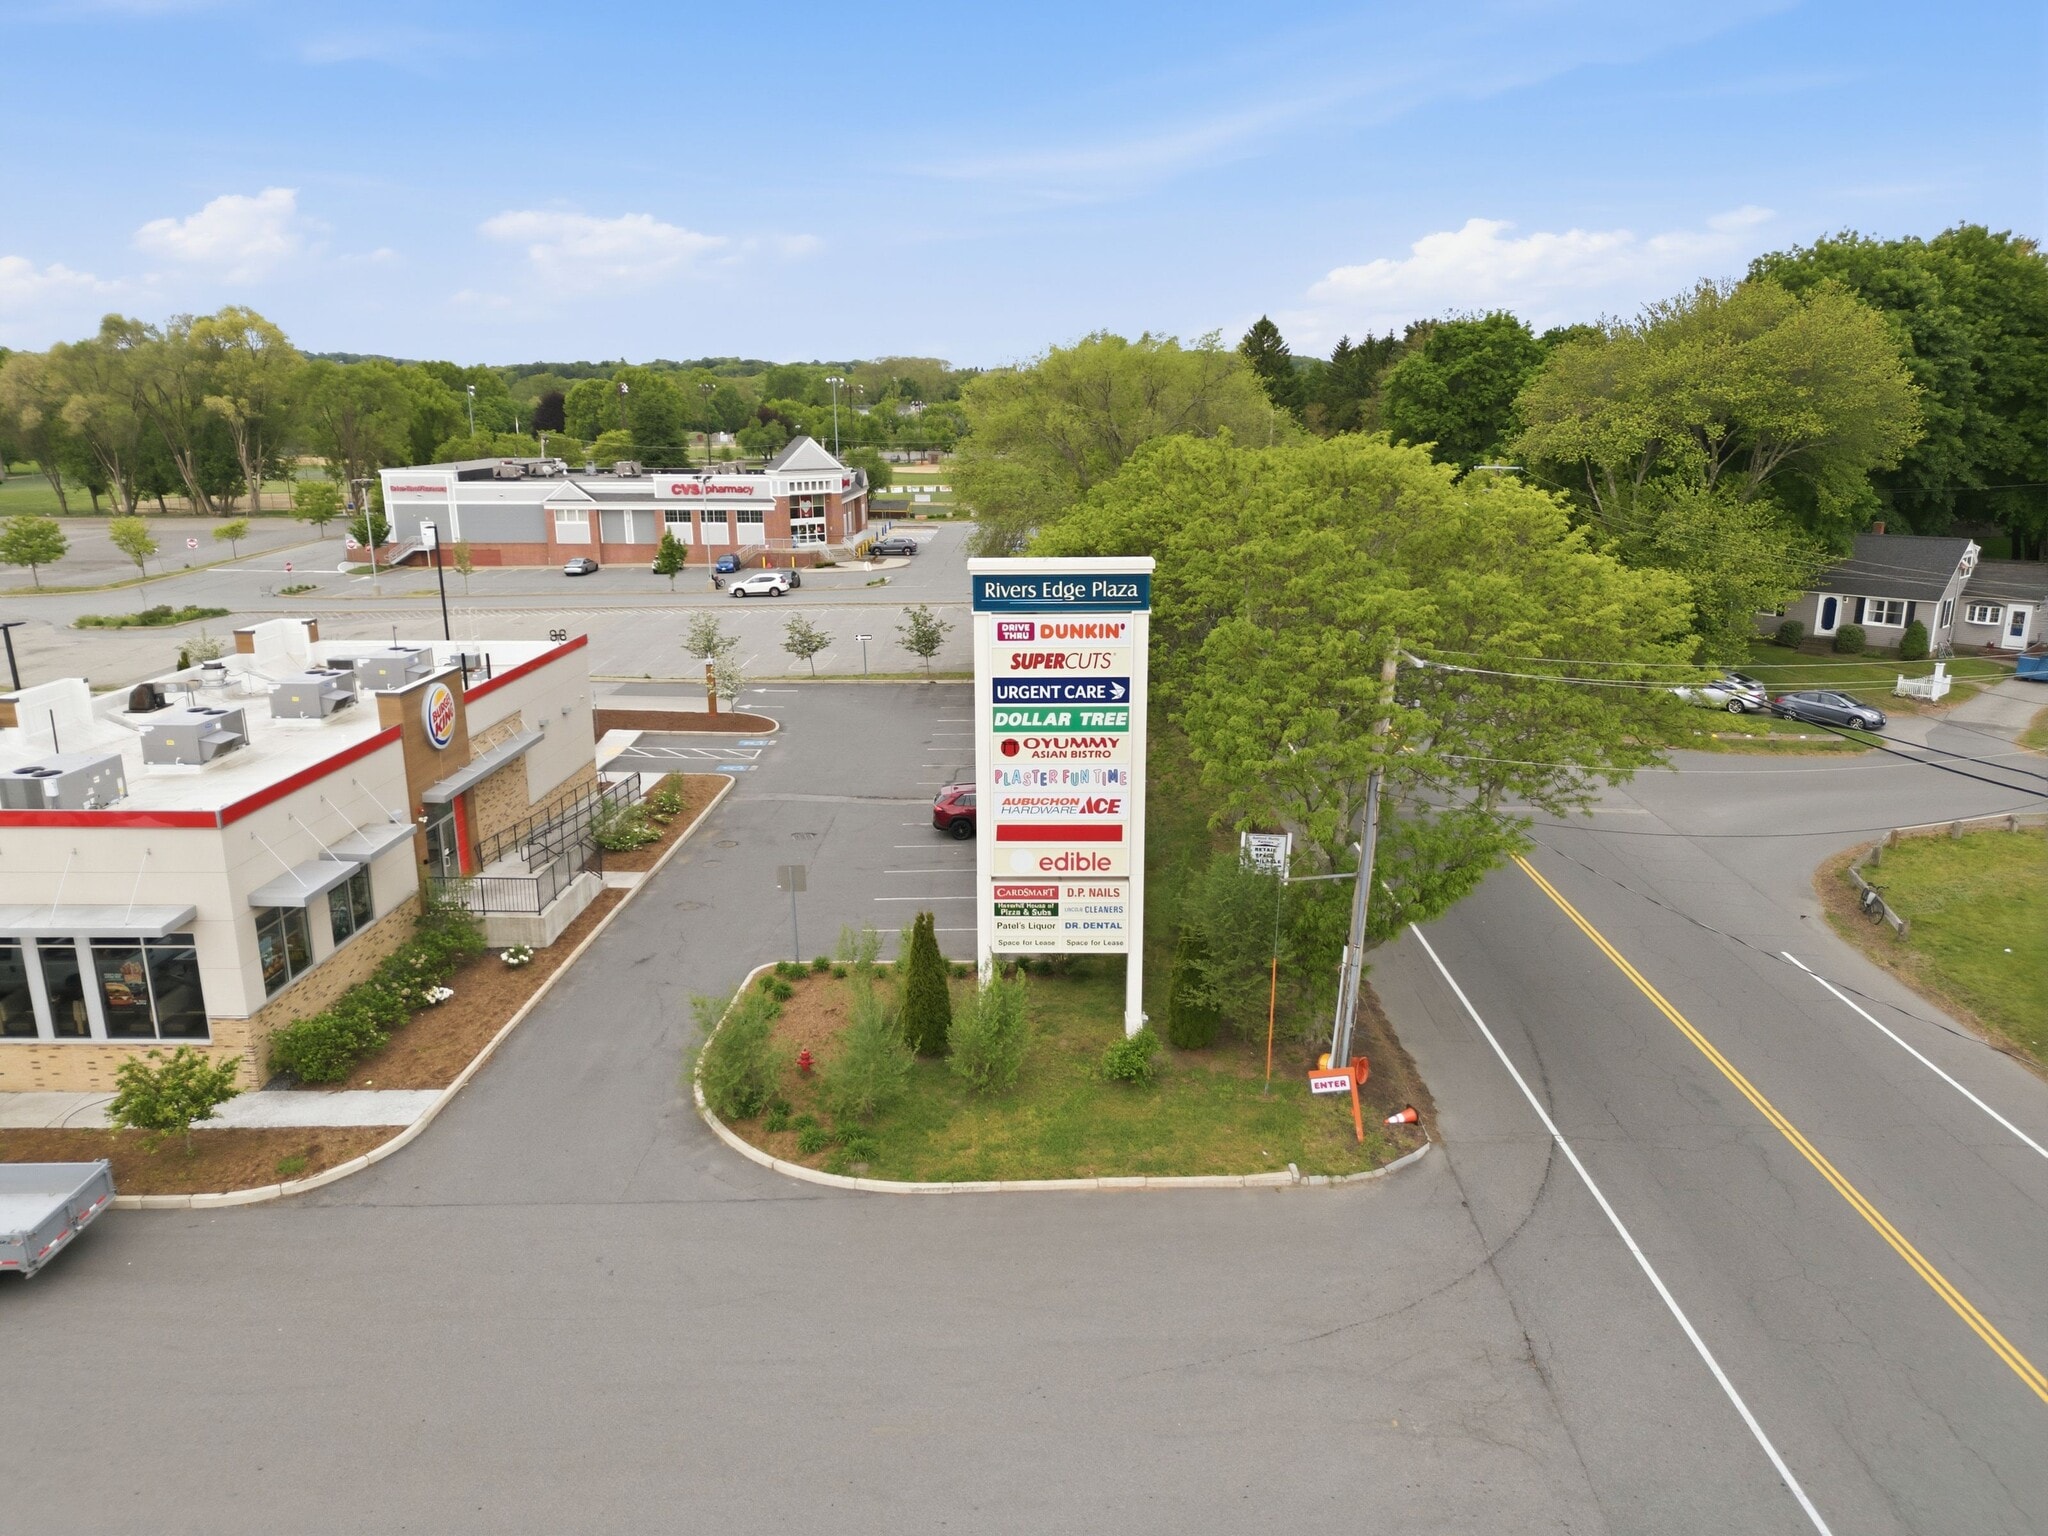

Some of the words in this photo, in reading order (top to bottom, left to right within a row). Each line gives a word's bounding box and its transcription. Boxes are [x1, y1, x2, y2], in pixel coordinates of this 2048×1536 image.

[671, 484, 700, 495] CVS
[705, 484, 754, 495] pharmacy
[985, 582, 1037, 598] Rivers
[1043, 581, 1086, 600] Edge
[1092, 581, 1138, 598] Plaza
[1040, 623, 1126, 639] DUNKIN'
[1010, 652, 1112, 670] SUPERCUTS
[997, 685, 1061, 699] URGENT
[1064, 685, 1106, 699] CARE
[432, 692, 453, 723] BURGER
[435, 702, 454, 737] KING
[994, 712, 1071, 726] DOLLAR
[1080, 711, 1128, 726] TREE
[1023, 737, 1119, 749] OYUMMY
[1071, 750, 1112, 758] BISTRO
[994, 769, 1059, 786] PLASTER
[1062, 769, 1090, 786] FUN
[1093, 769, 1128, 786] TIME
[1001, 797, 1080, 806] AUBUCHON
[1079, 796, 1122, 814] ACE
[1001, 806, 1077, 814] HARDWARE
[1039, 851, 1112, 872] edible
[1067, 888, 1086, 897] D.P.
[1089, 888, 1120, 897] NAILS
[1084, 905, 1124, 913] CLEANERS
[1028, 922, 1056, 930] Liquor
[1314, 1080, 1347, 1089] ENTER
